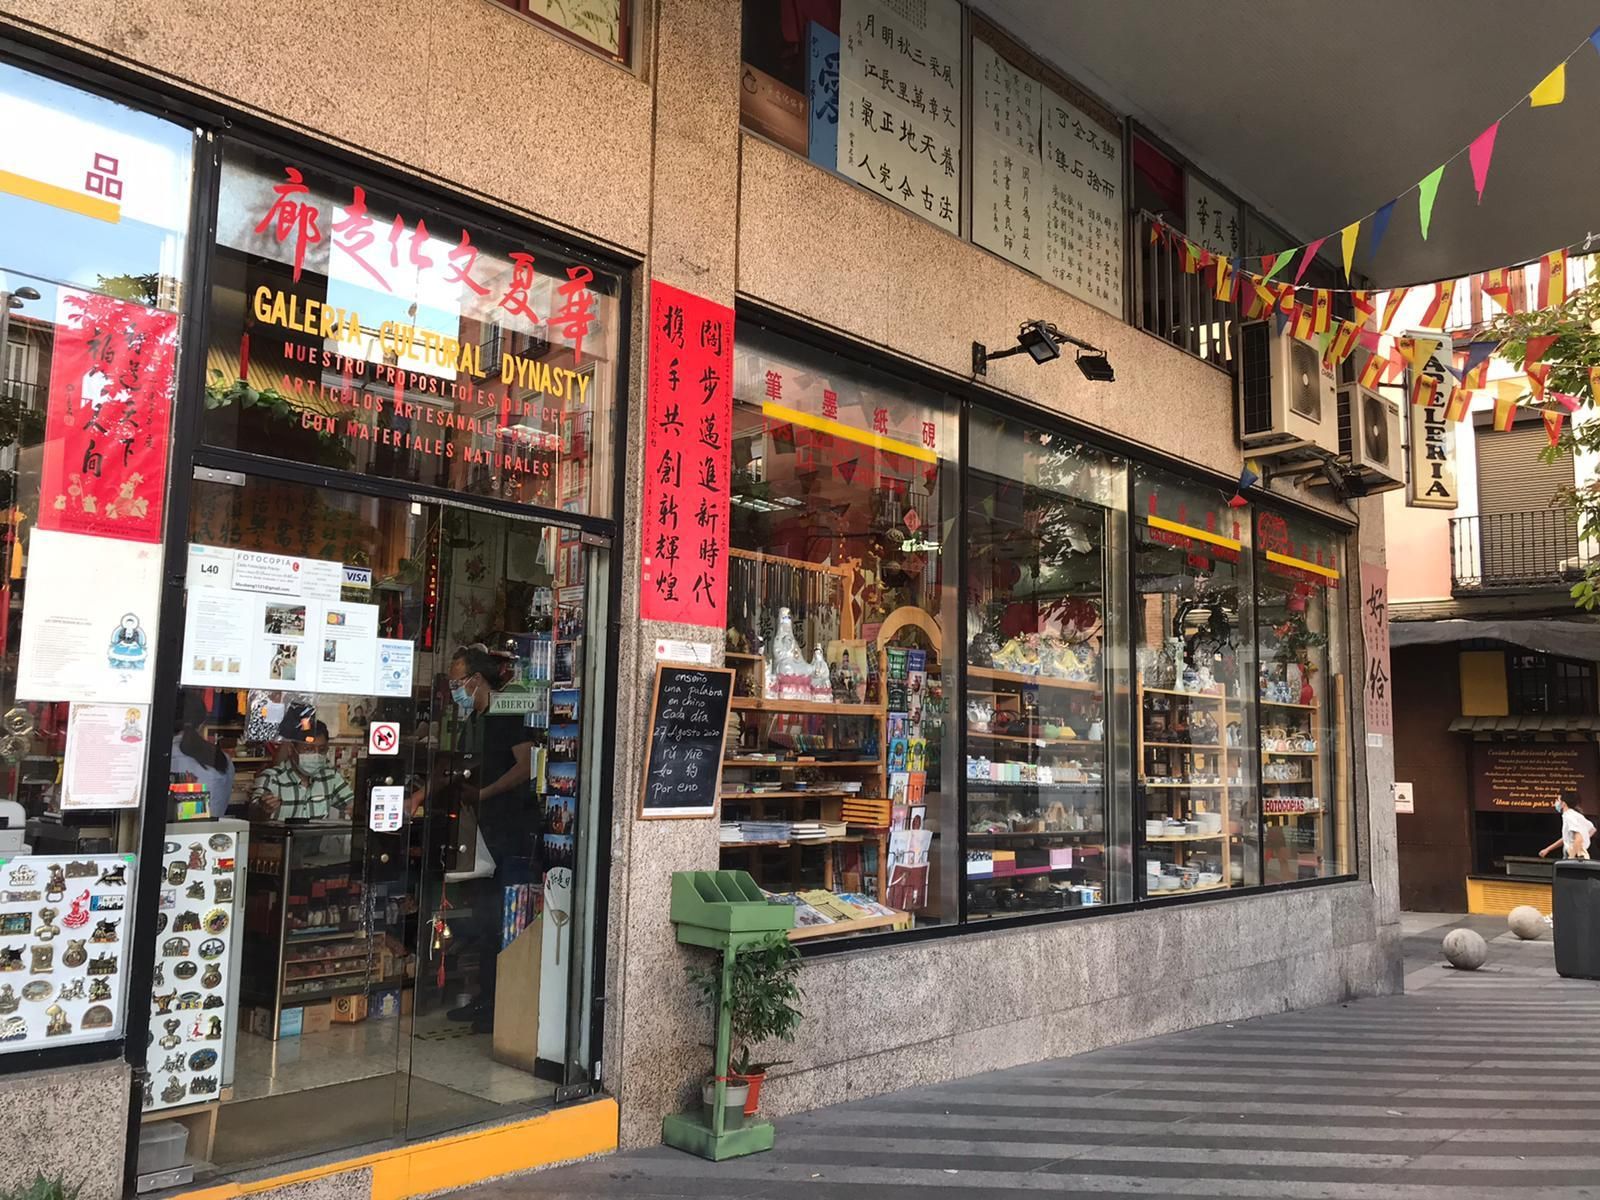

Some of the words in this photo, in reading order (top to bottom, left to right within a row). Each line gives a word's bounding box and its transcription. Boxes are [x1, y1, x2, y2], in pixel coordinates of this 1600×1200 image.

[85, 153, 123, 200] 品
[254, 286, 363, 347] GALERIA
[380, 320, 487, 379] CULTURAL
[501, 352, 590, 403] DYNASTY
[284, 341, 366, 377] NUESTRO
[376, 364, 468, 400] PROPOSITO
[478, 389, 496, 408] ES
[281, 374, 384, 413] ARTICULOS
[395, 396, 504, 440] ARTESANALES
[301, 413, 336, 435] CON
[346, 422, 455, 459] MATERIALES
[464, 446, 550, 478] NATURALES
[237, 553, 291, 566] FOTOCOPIA
[200, 563, 220, 575] L40
[346, 571, 368, 583] VISA
[663, 686, 682, 694] una
[688, 684, 723, 701] palabra
[495, 700, 535, 710] ABIERTO
[668, 698, 680, 706] en
[1265, 800, 1305, 812] FOTOCOPIAS
